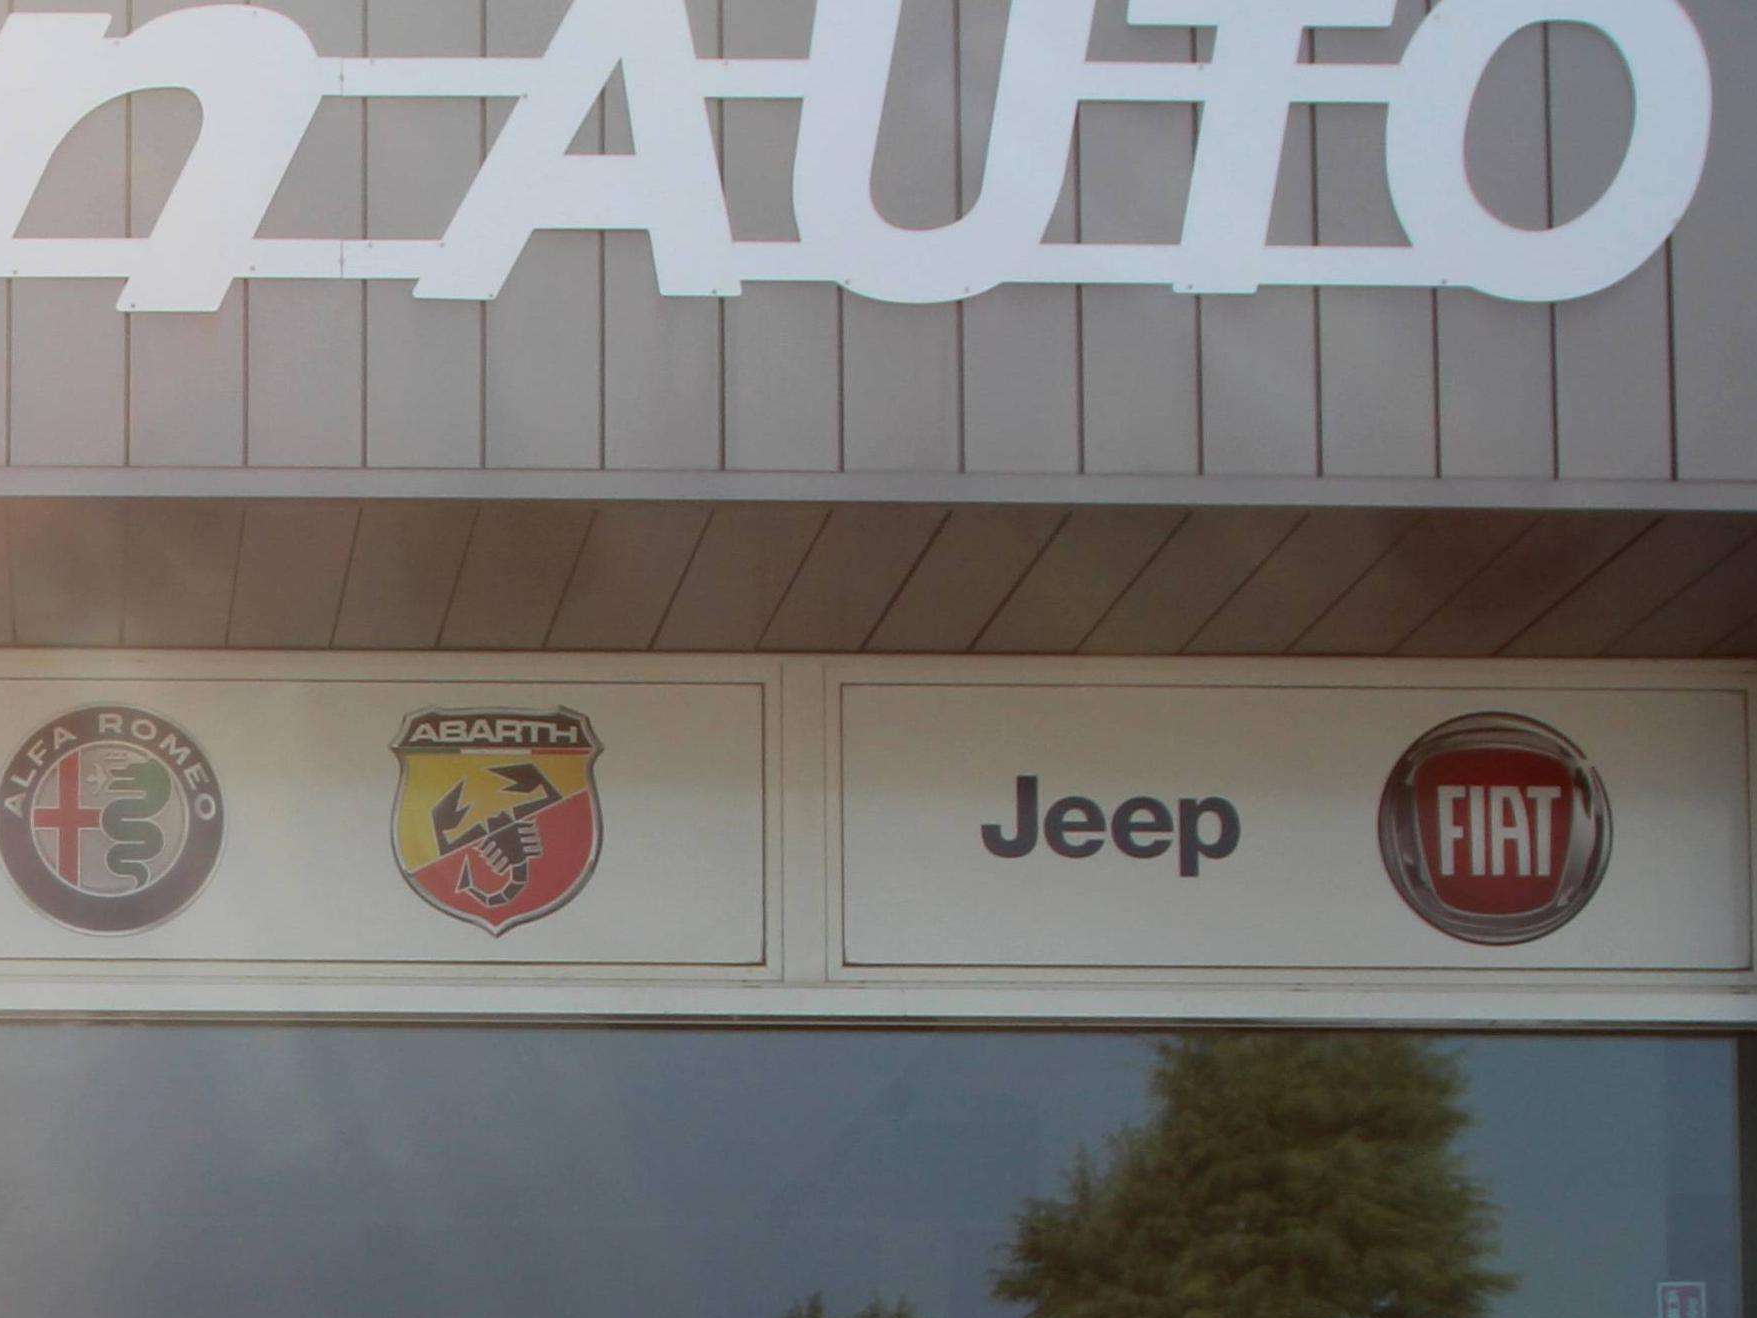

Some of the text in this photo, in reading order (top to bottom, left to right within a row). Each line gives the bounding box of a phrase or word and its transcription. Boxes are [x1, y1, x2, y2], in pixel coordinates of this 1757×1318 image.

[4, 713, 217, 822] ALFA ROMEO
[408, 718, 578, 744] ABARTH
[981, 775, 1240, 877] Jeep
[1436, 785, 1562, 876] FIAT
